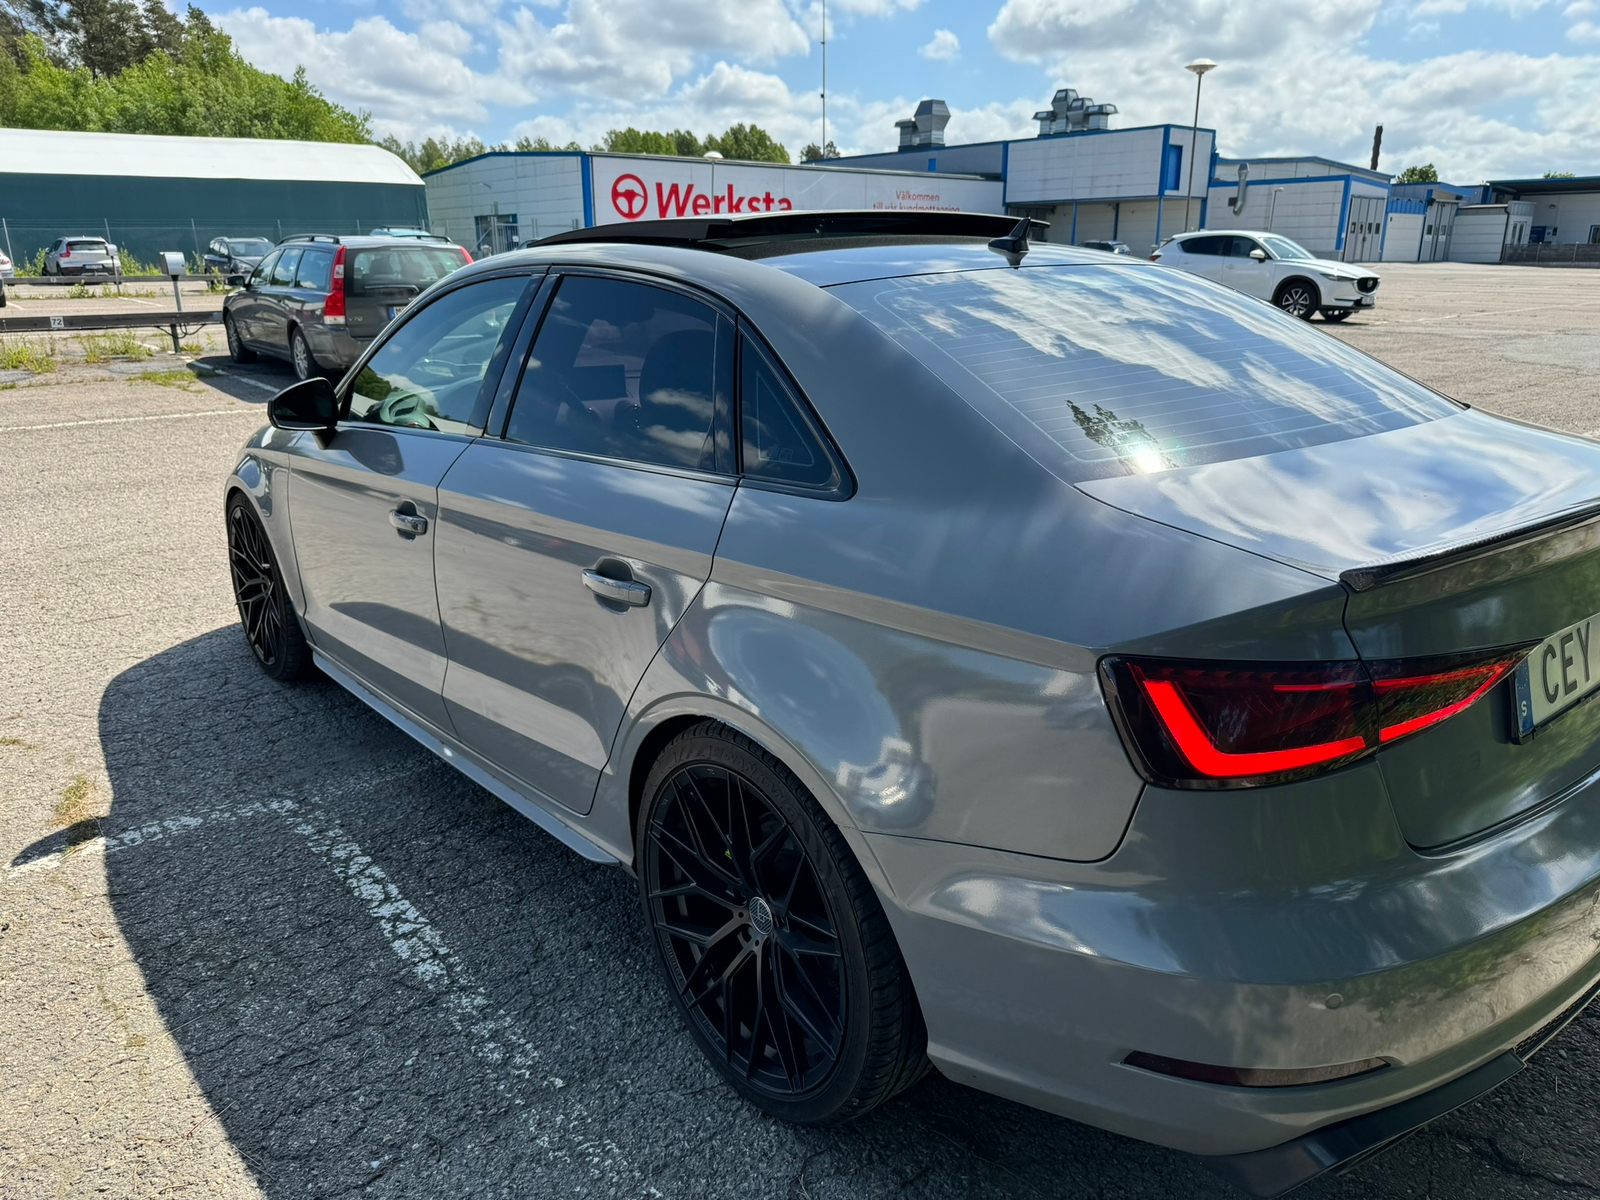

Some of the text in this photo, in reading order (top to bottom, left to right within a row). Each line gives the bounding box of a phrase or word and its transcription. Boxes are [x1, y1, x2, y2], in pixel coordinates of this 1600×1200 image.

[655, 182, 792, 219] Werksta
[895, 190, 940, 201] Välkommen
[873, 202, 883, 210] till
[51, 318, 63, 326] 72
[1542, 621, 1590, 704] CEY
[1520, 700, 1528, 717] S
